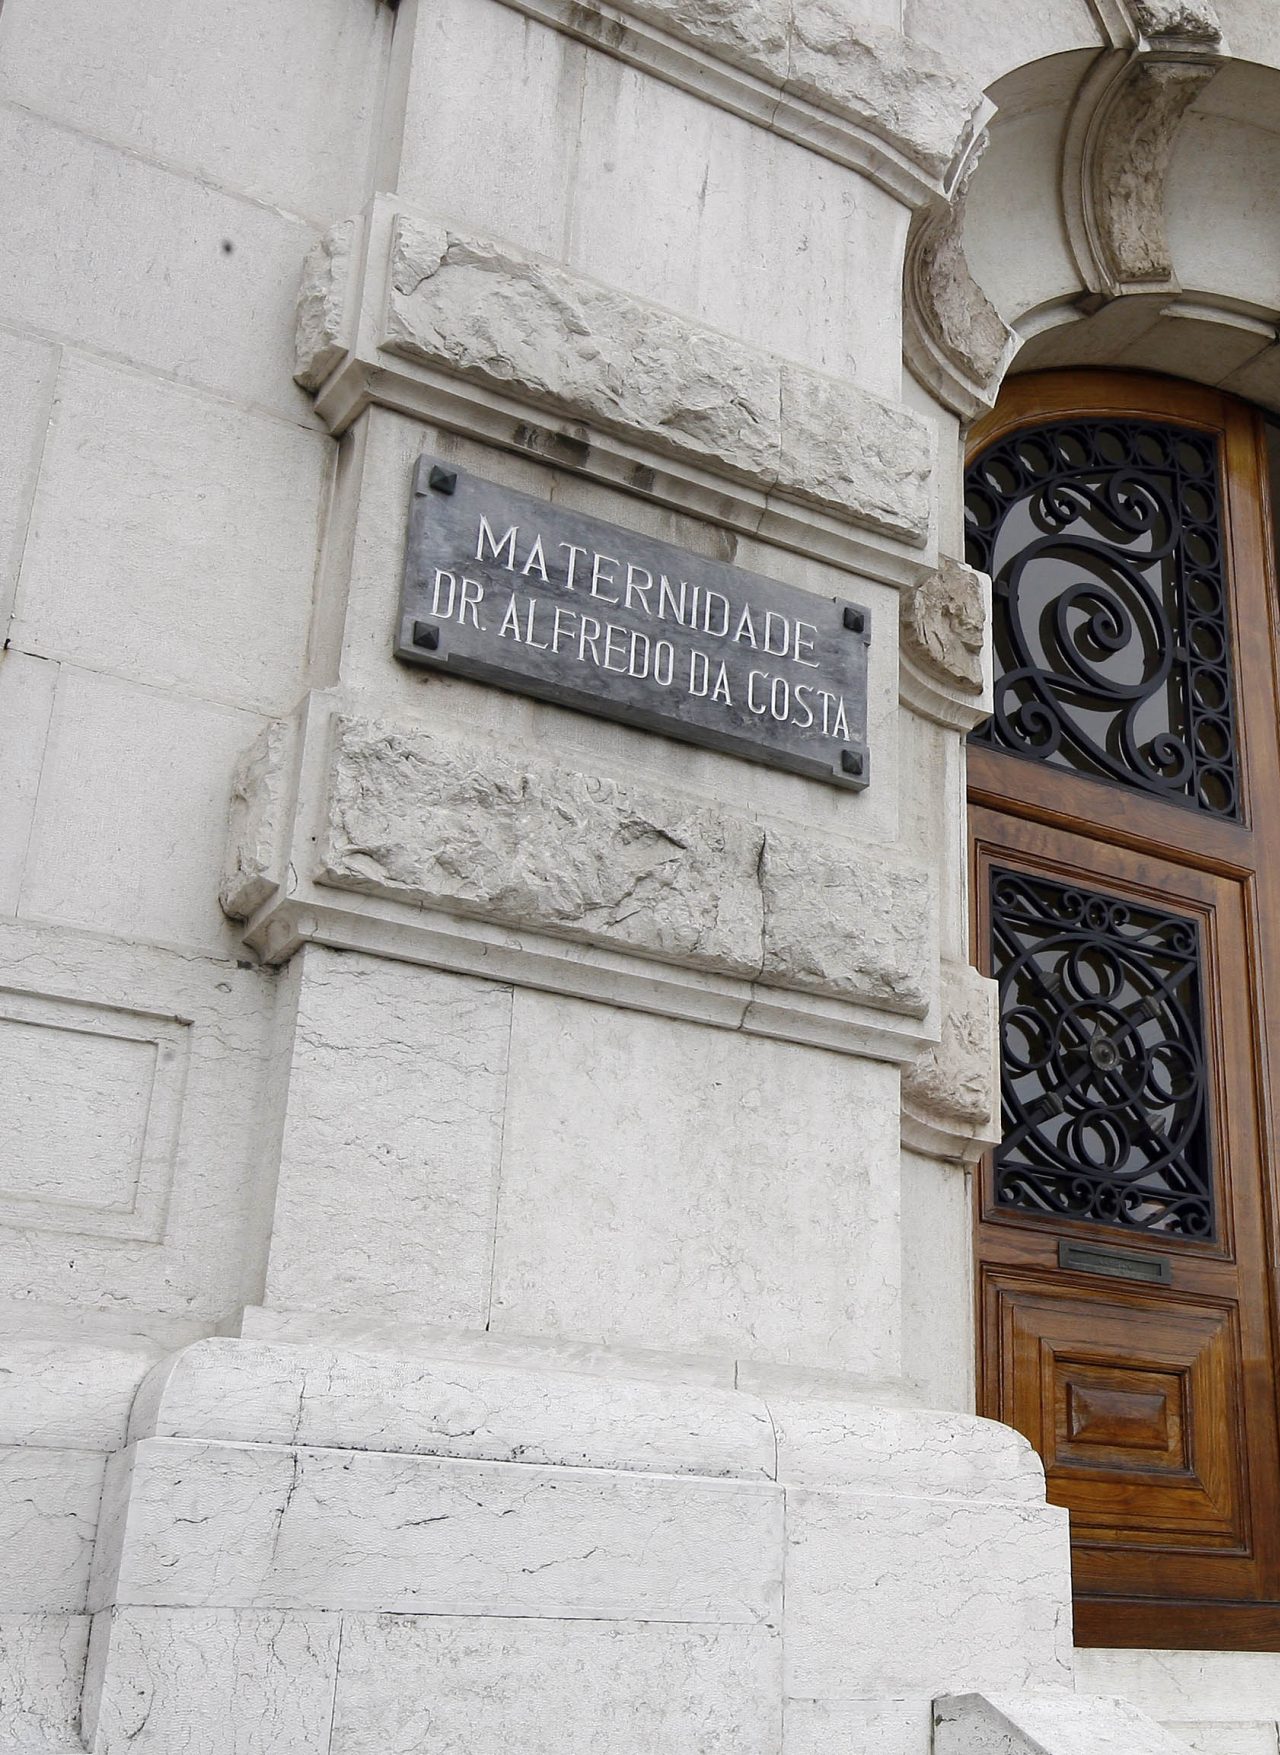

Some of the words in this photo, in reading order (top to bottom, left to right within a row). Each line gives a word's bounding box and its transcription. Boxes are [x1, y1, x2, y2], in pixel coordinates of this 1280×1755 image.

[430, 567, 487, 631] DR.
[498, 592, 674, 686] ALFREDO
[688, 648, 733, 707] DA
[747, 670, 852, 742] COSTA
[474, 513, 820, 668] MATERNIDADE
